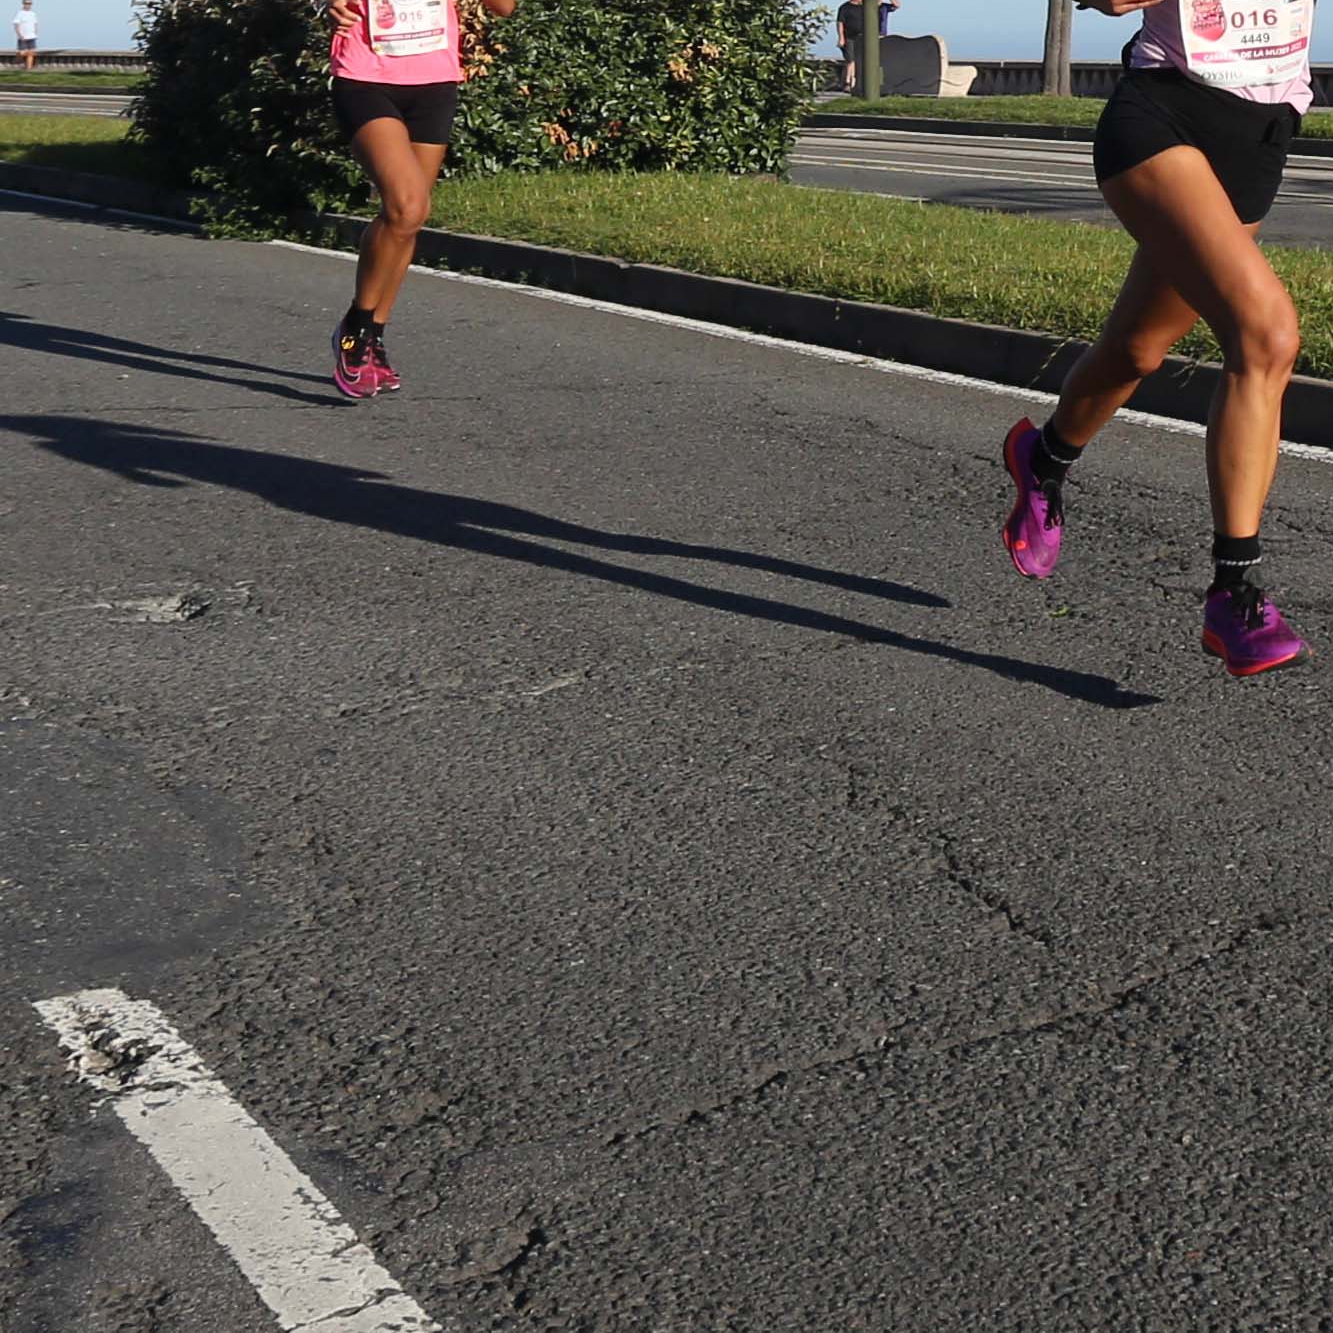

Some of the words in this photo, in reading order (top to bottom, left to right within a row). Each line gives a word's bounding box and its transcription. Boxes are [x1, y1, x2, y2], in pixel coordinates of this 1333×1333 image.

[1231, 9, 1278, 29] 016
[1240, 33, 1270, 45] 4449
[1240, 51, 1252, 59] DE
[1254, 49, 1264, 57] LA
